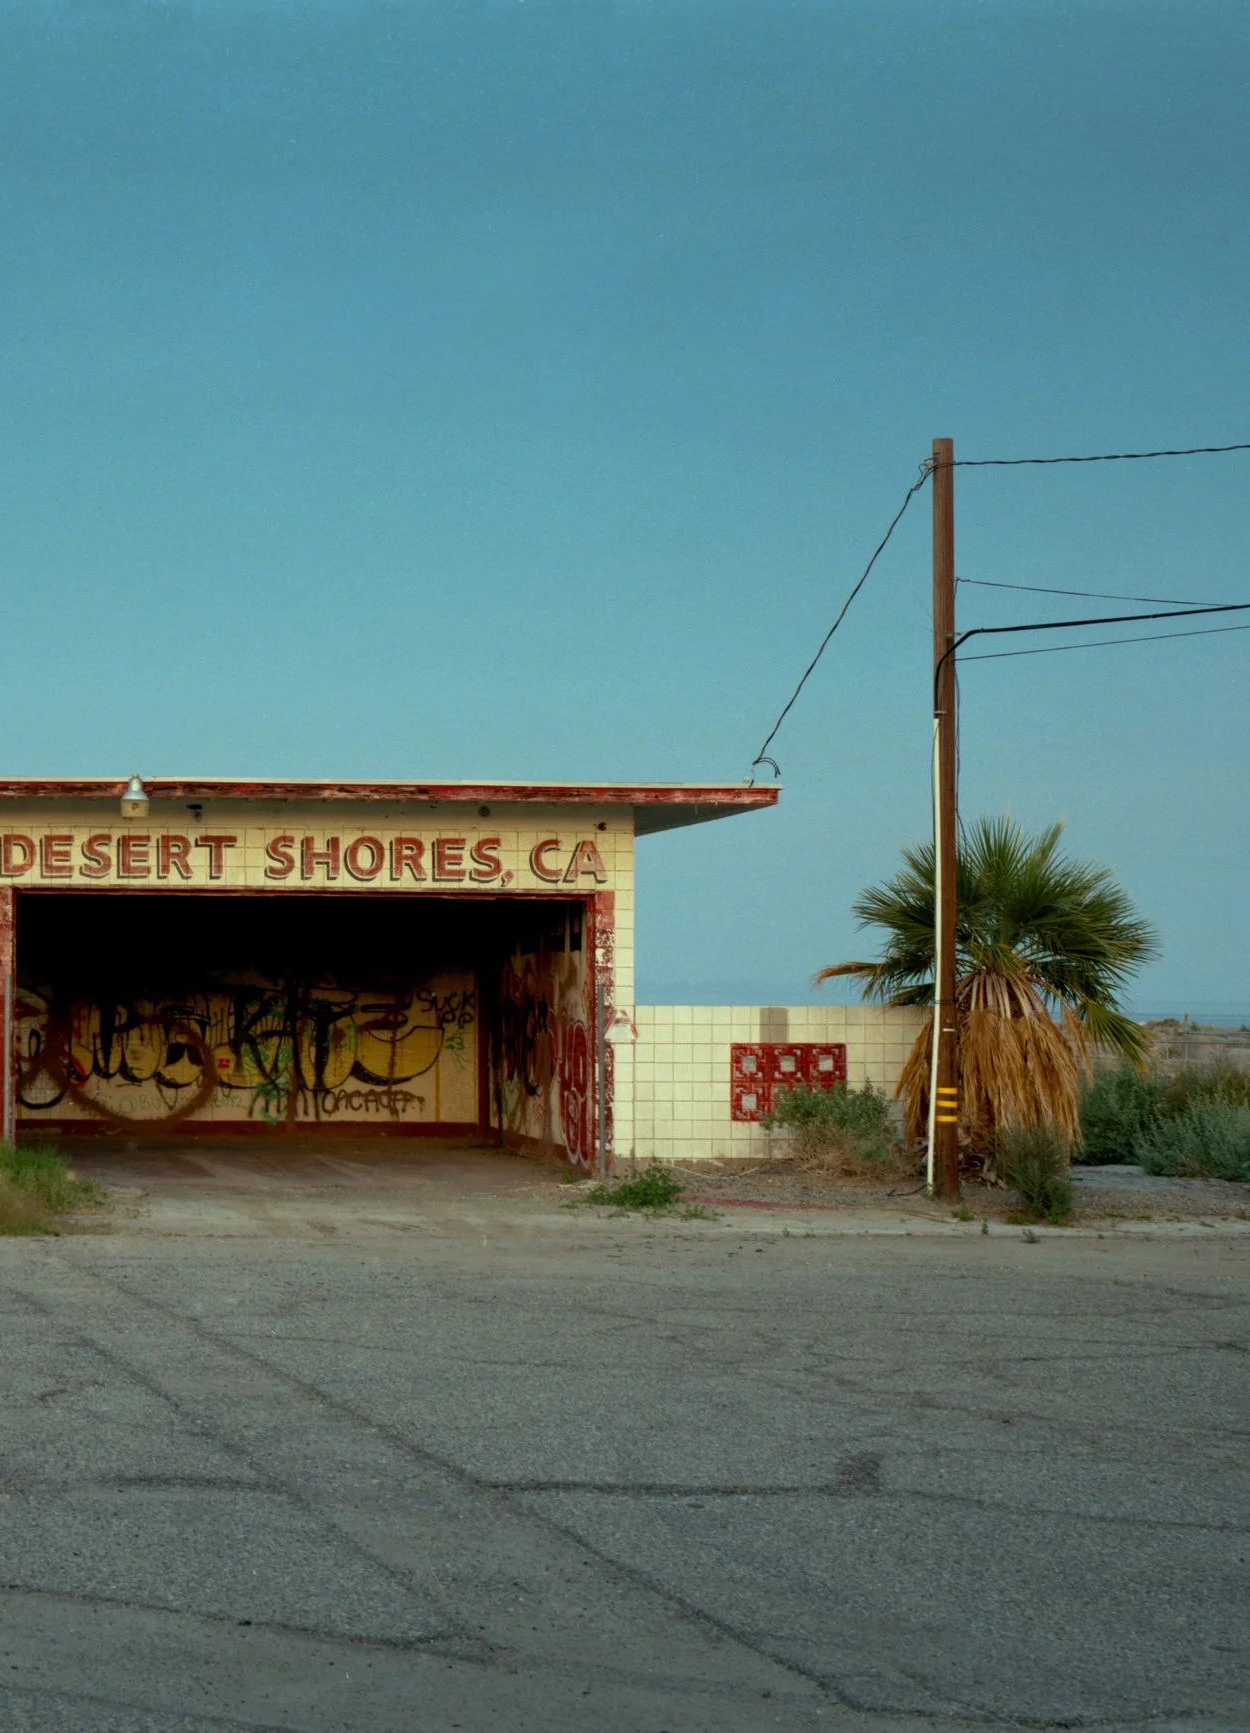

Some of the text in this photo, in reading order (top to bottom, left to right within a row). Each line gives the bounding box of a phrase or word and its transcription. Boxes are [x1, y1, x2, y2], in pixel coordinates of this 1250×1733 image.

[0, 833, 607, 886] DESERT SHORES, CA
[416, 987, 476, 1013] SUCK
